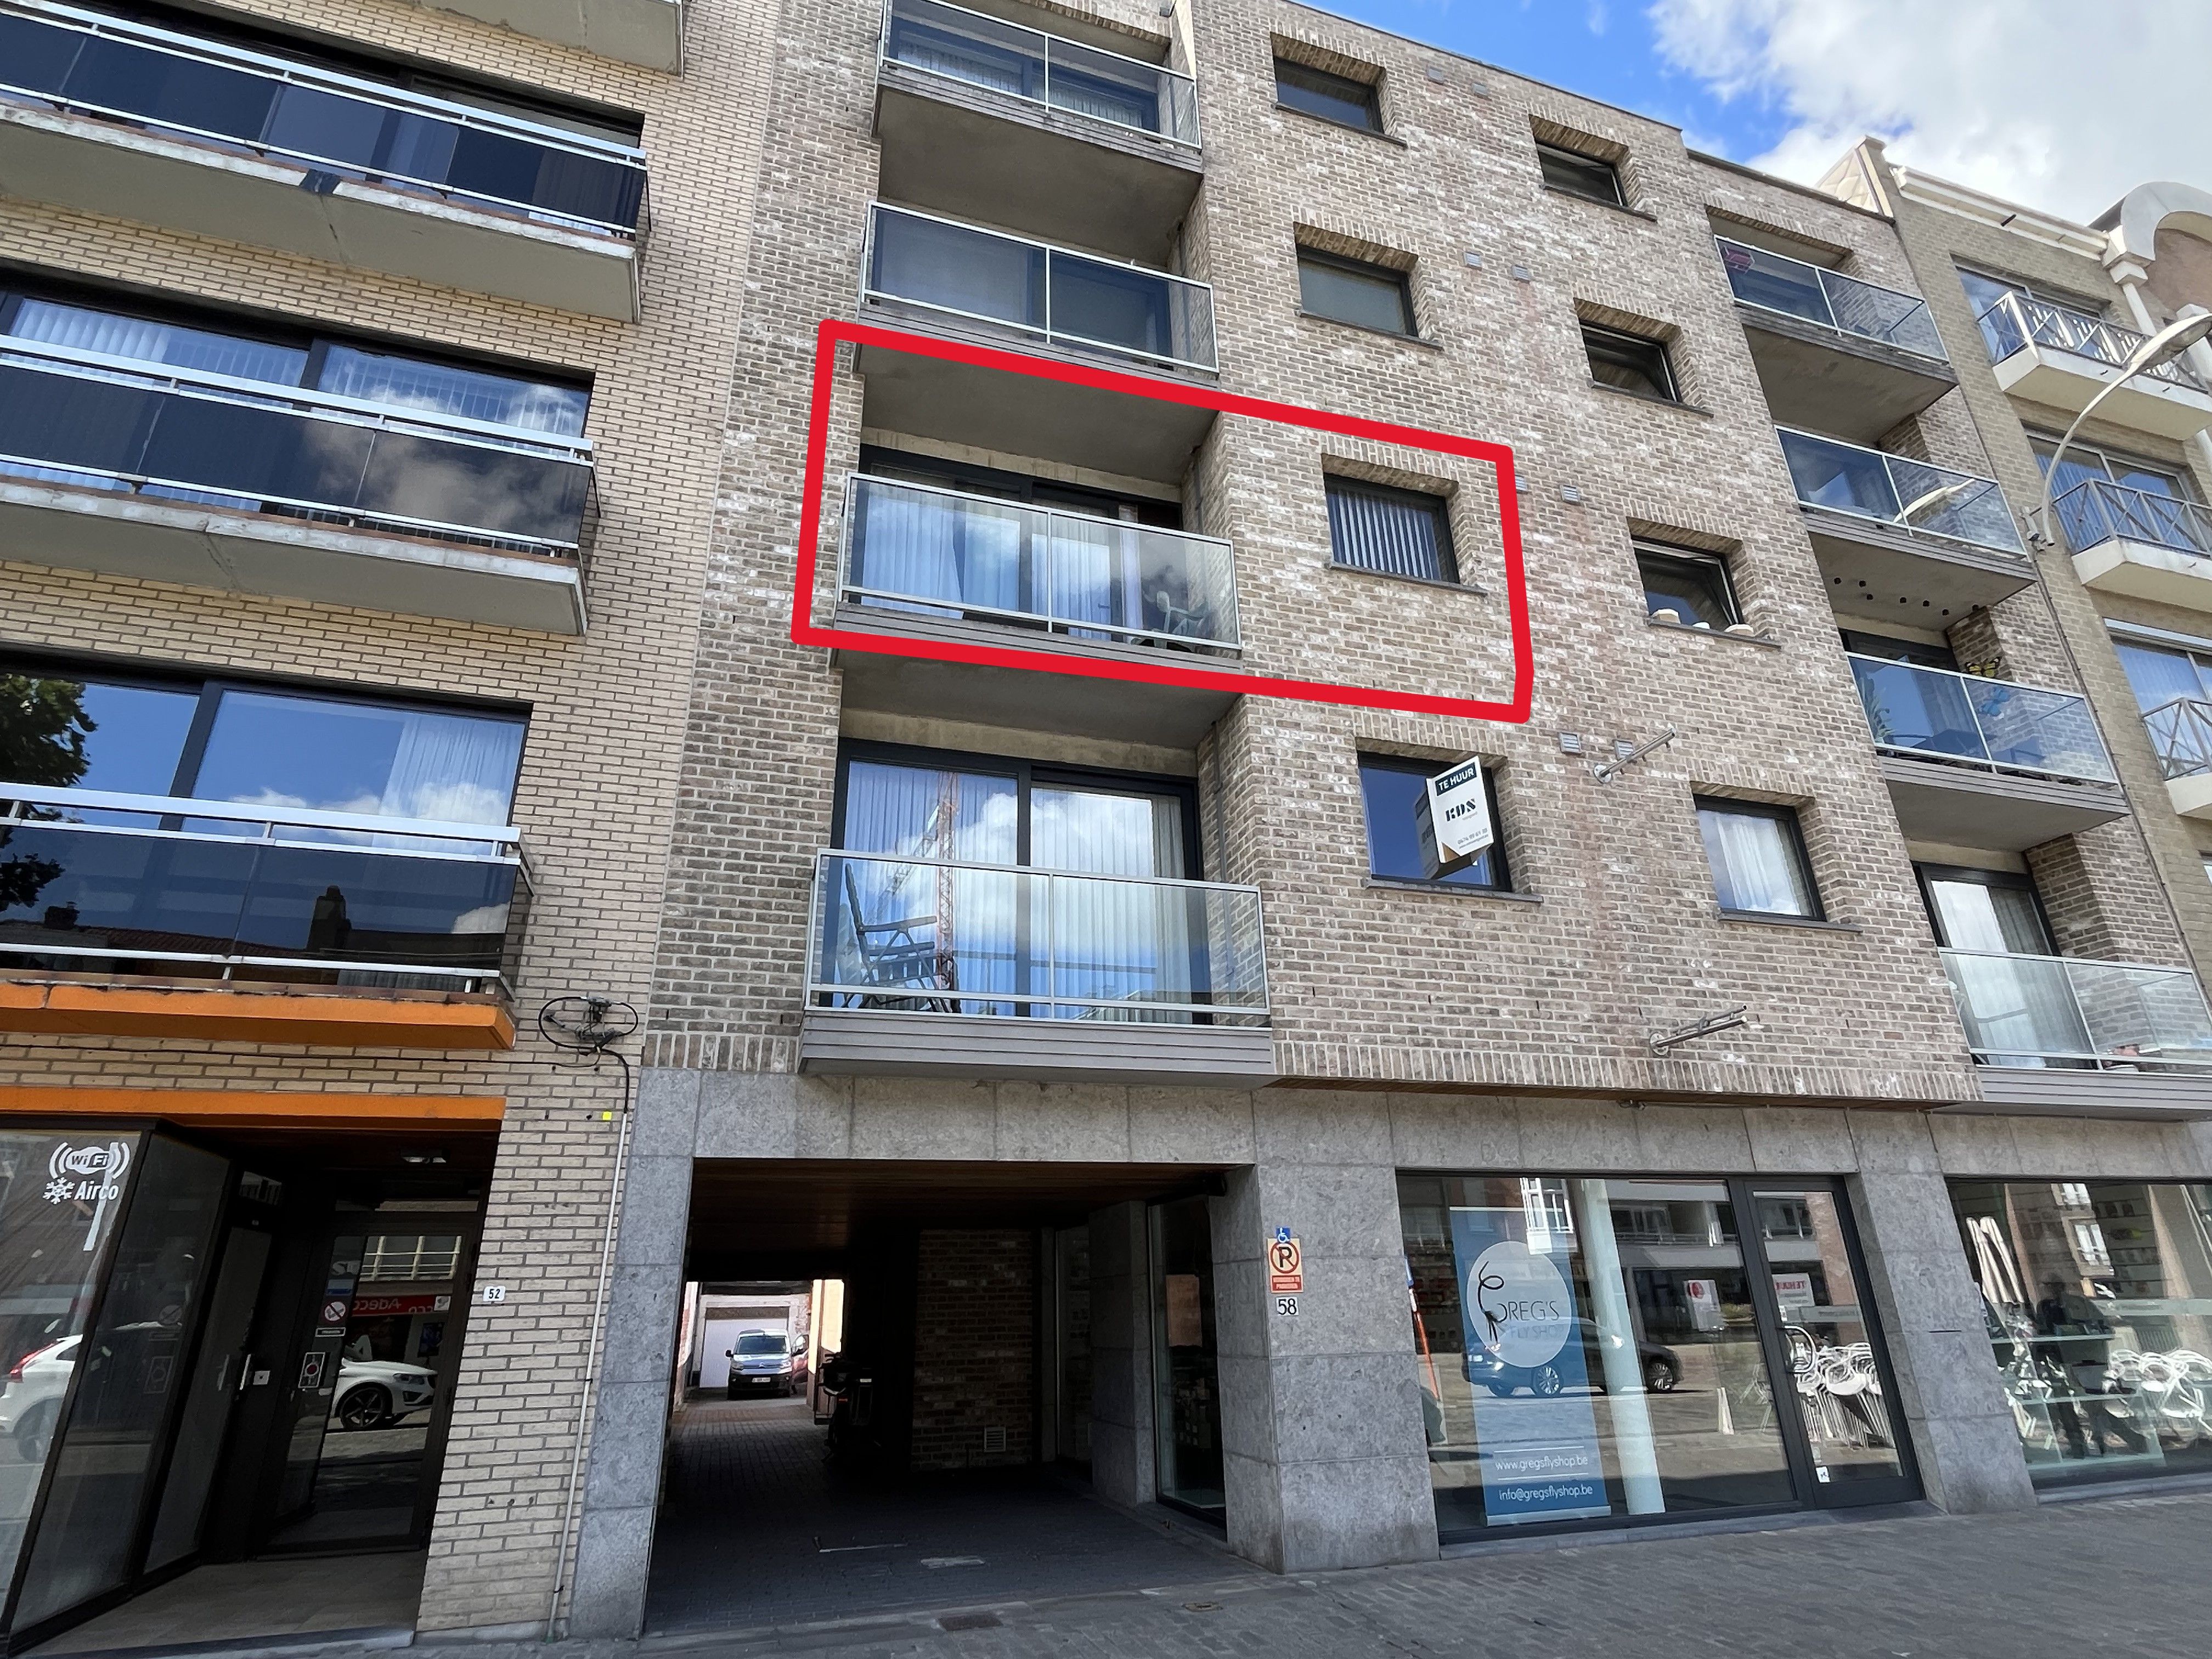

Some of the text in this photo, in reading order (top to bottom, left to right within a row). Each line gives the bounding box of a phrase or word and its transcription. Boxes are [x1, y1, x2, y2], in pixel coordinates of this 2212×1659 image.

[1438, 767, 1475, 791] TE HUUR
[71, 1154, 108, 1165] WiFi
[74, 1180, 119, 1200] Airco
[488, 1288, 500, 1299] 52
[1278, 1298, 1297, 1316] 58
[1495, 1454, 1588, 1472] www.gregsflyshop.be
